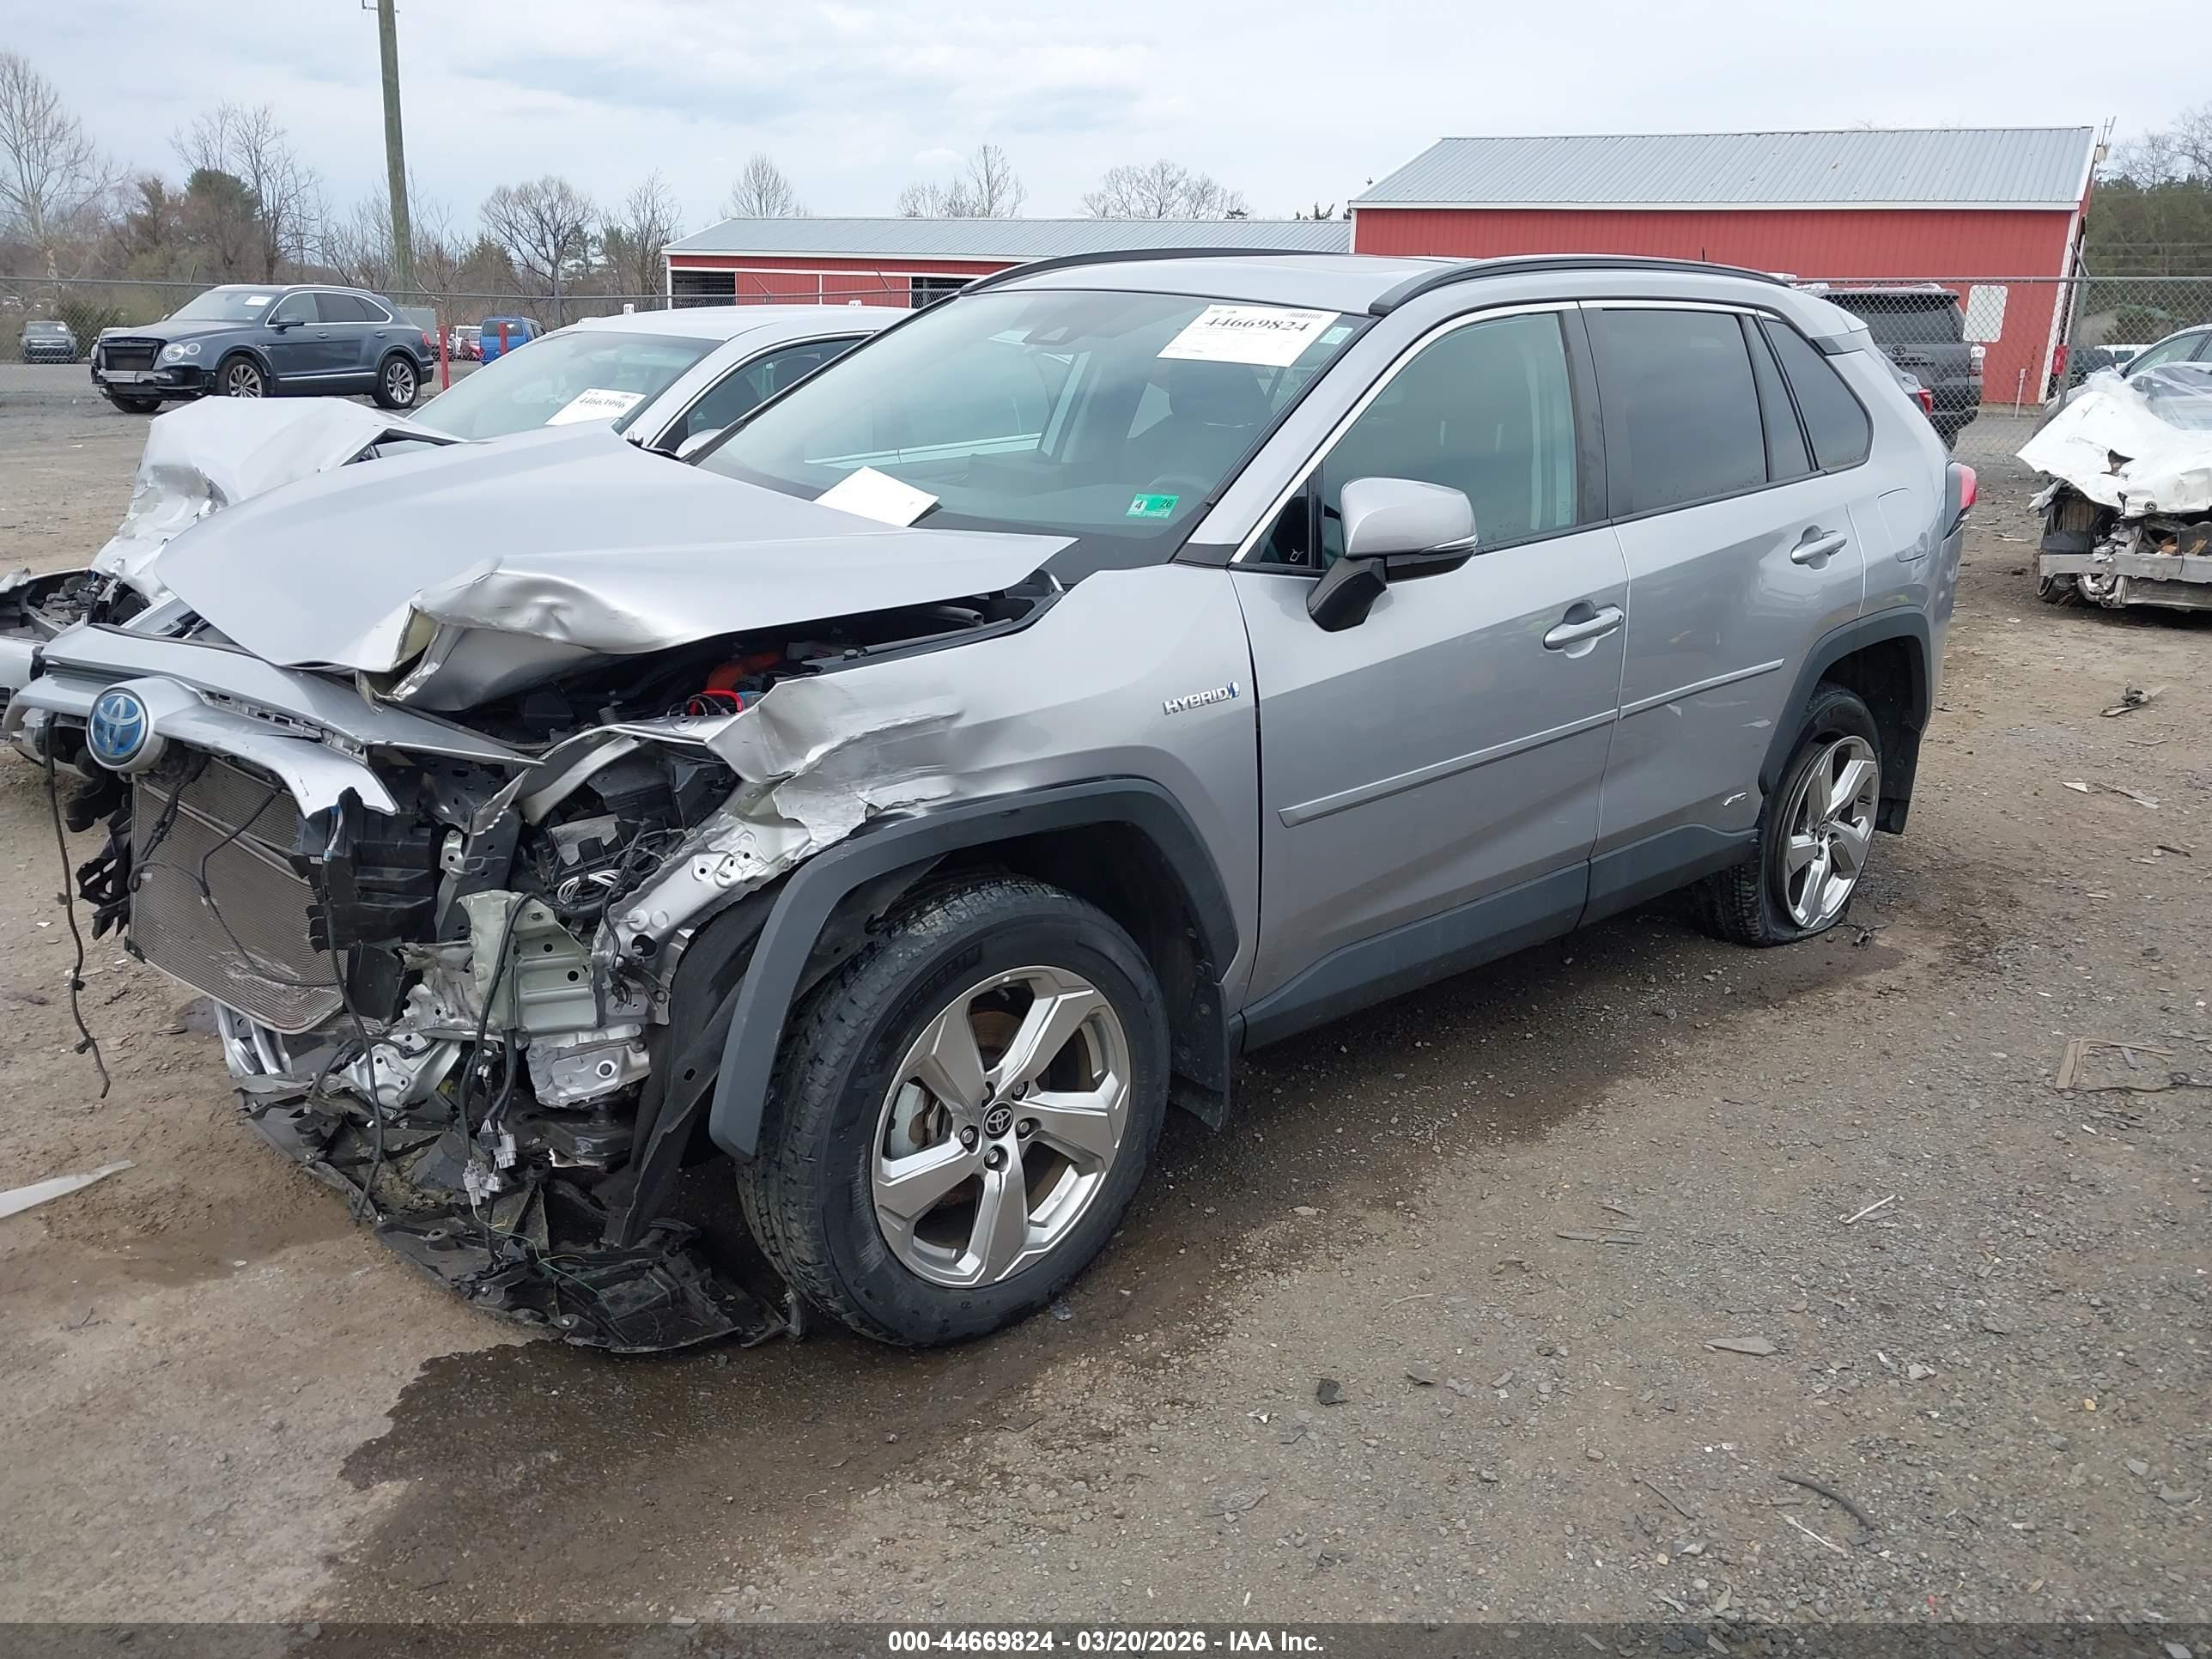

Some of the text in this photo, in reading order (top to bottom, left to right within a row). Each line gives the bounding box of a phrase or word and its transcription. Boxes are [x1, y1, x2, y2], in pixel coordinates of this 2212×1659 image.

[1205, 317, 1310, 331] 44669824
[1134, 499, 1175, 509] 4 26
[1163, 687, 1230, 715] HYBRID
